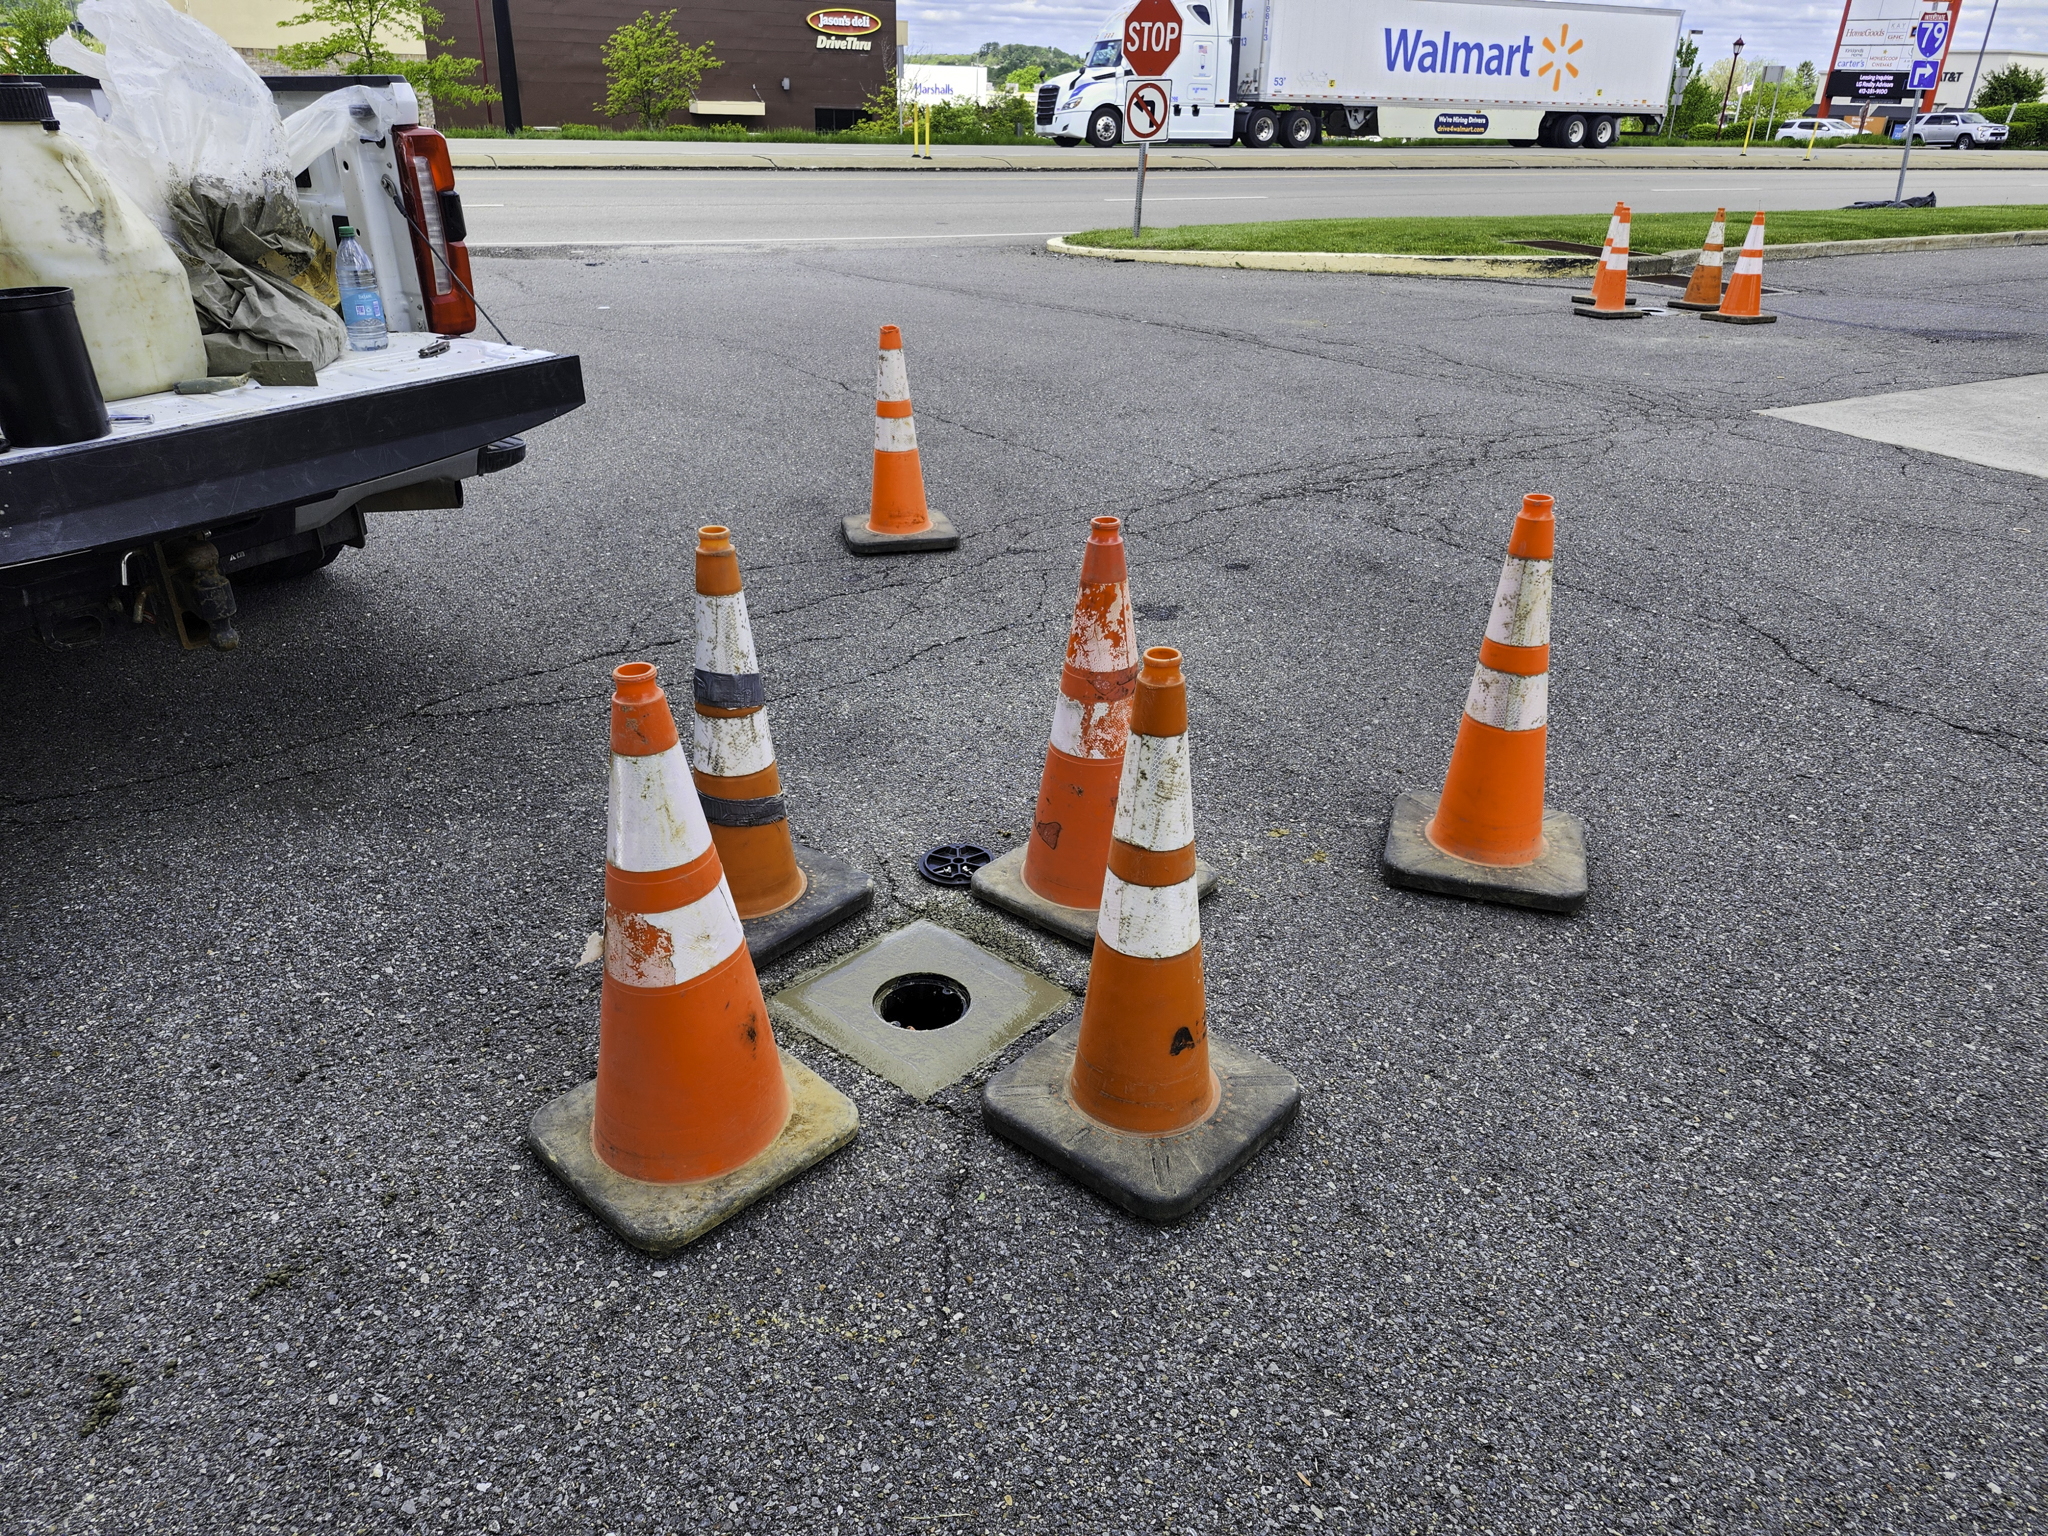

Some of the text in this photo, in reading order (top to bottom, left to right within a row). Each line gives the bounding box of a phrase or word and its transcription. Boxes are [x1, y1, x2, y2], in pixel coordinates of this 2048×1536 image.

[818, 14, 870, 28] Jason's deli
[1126, 21, 1180, 52] STOP
[1845, 28, 1885, 37] HomeGoods
[1921, 22, 1945, 48] 79
[816, 35, 872, 51] DriveThru
[1384, 27, 1534, 77] Walmart
[914, 83, 953, 95] Marshalls
[1453, 116, 1468, 125] Hiring
